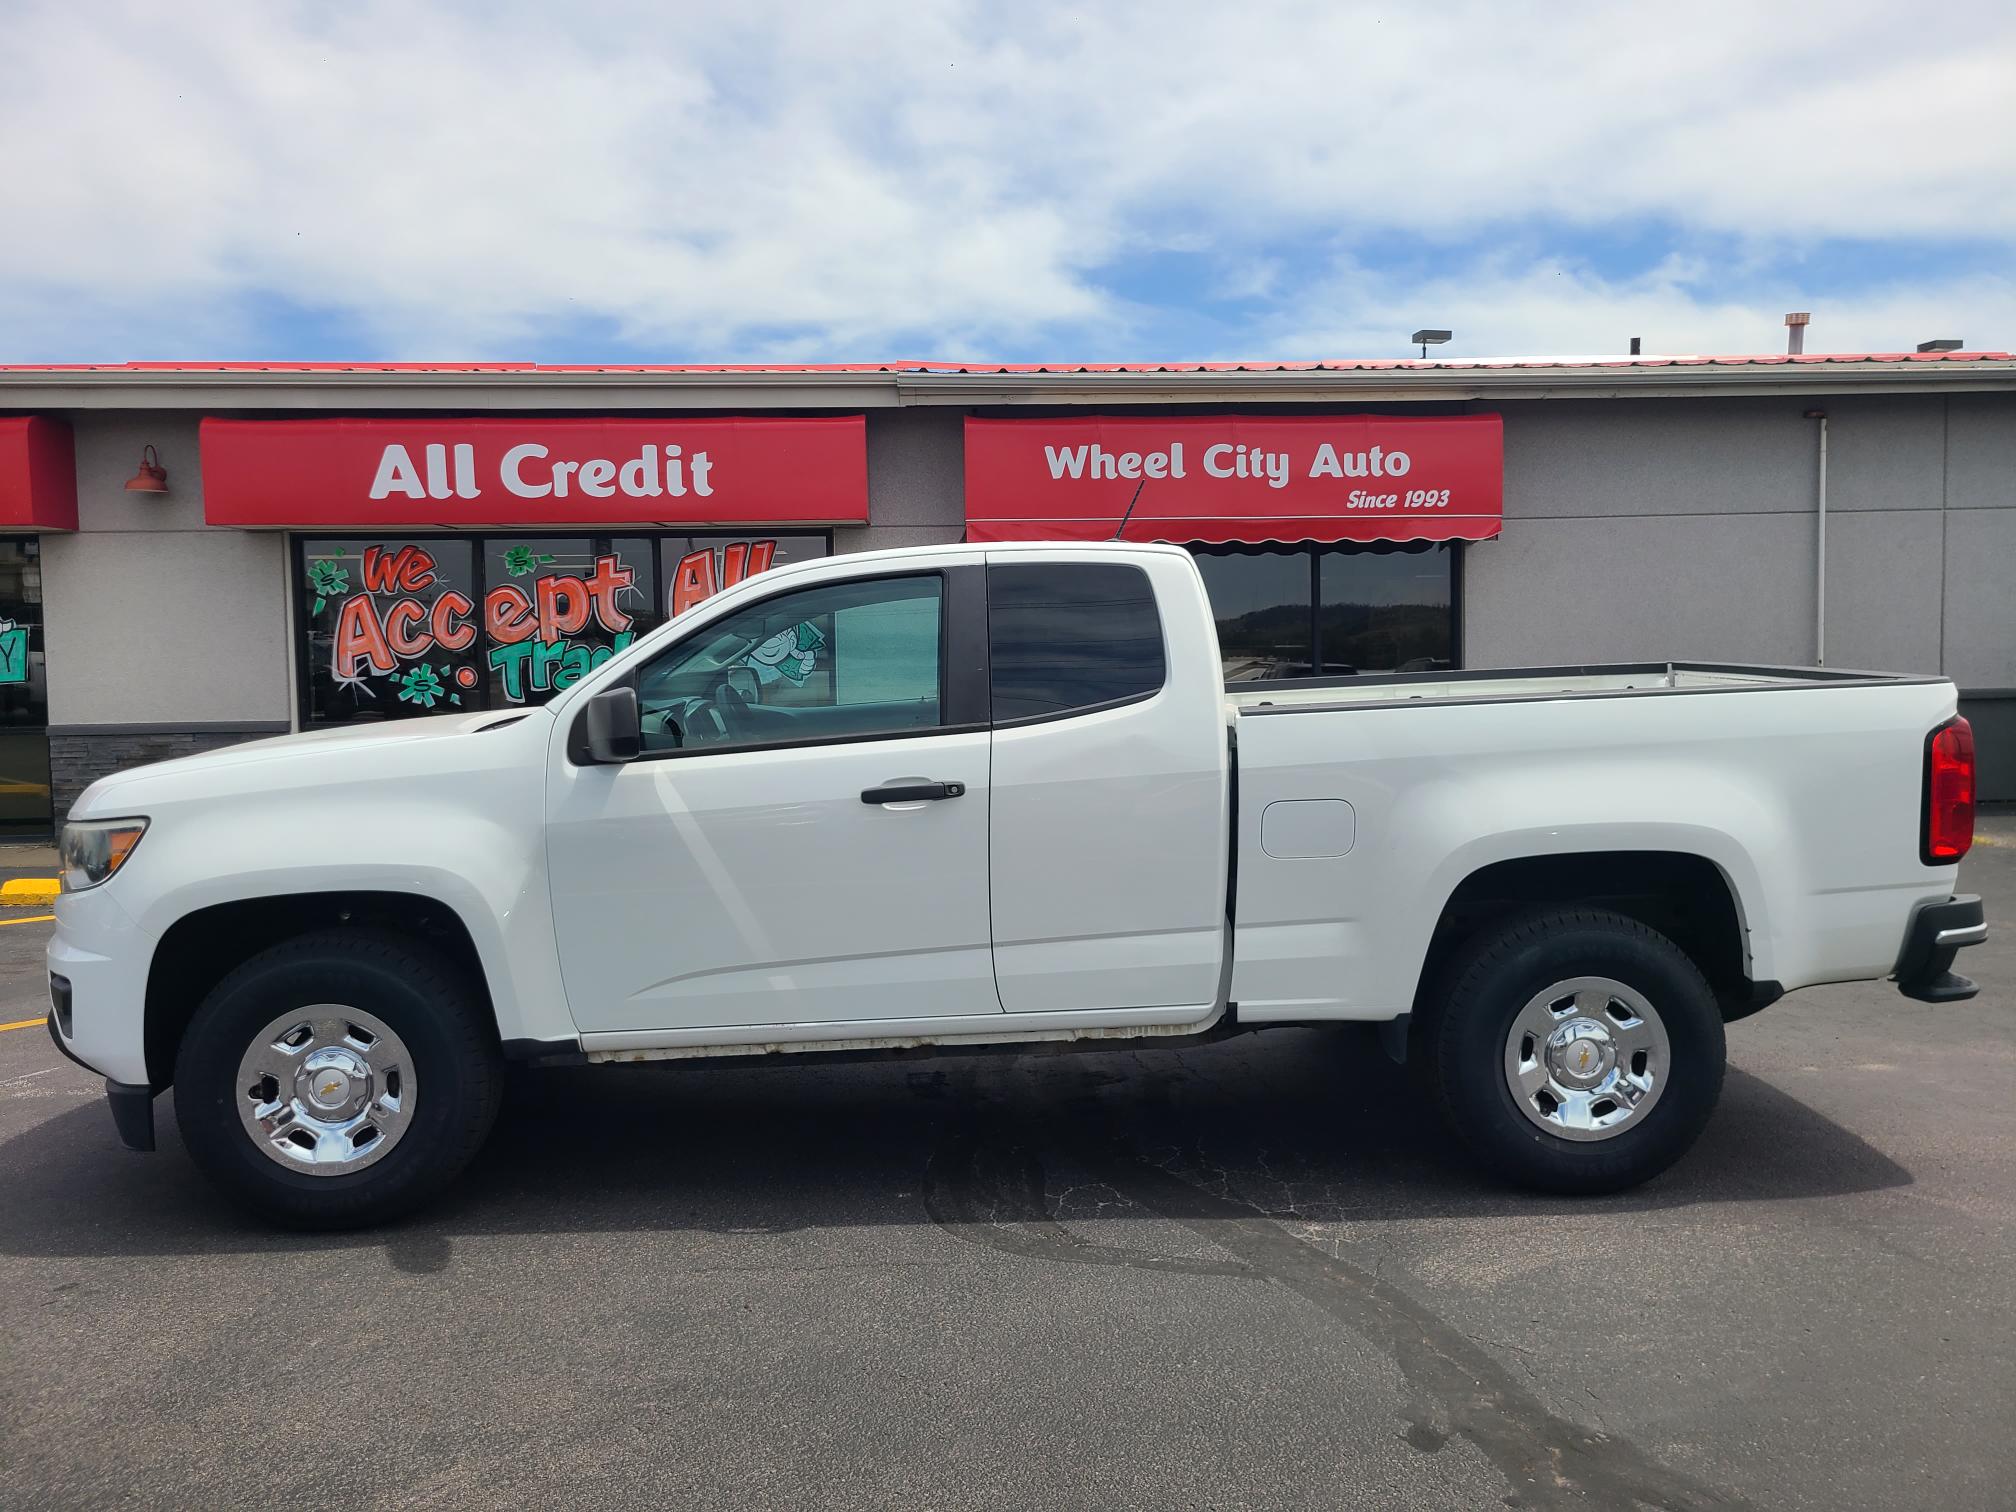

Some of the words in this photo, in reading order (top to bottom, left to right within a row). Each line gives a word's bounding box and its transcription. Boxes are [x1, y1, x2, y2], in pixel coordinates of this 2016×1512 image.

[369, 443, 482, 499] All
[500, 443, 714, 498] Credit
[1044, 443, 1186, 479] Wheel
[1203, 443, 1289, 488] City
[1309, 443, 1411, 478] Auto
[1346, 490, 1398, 509] Since
[1403, 489, 1450, 508] 1993
[334, 553, 634, 680] Accept
